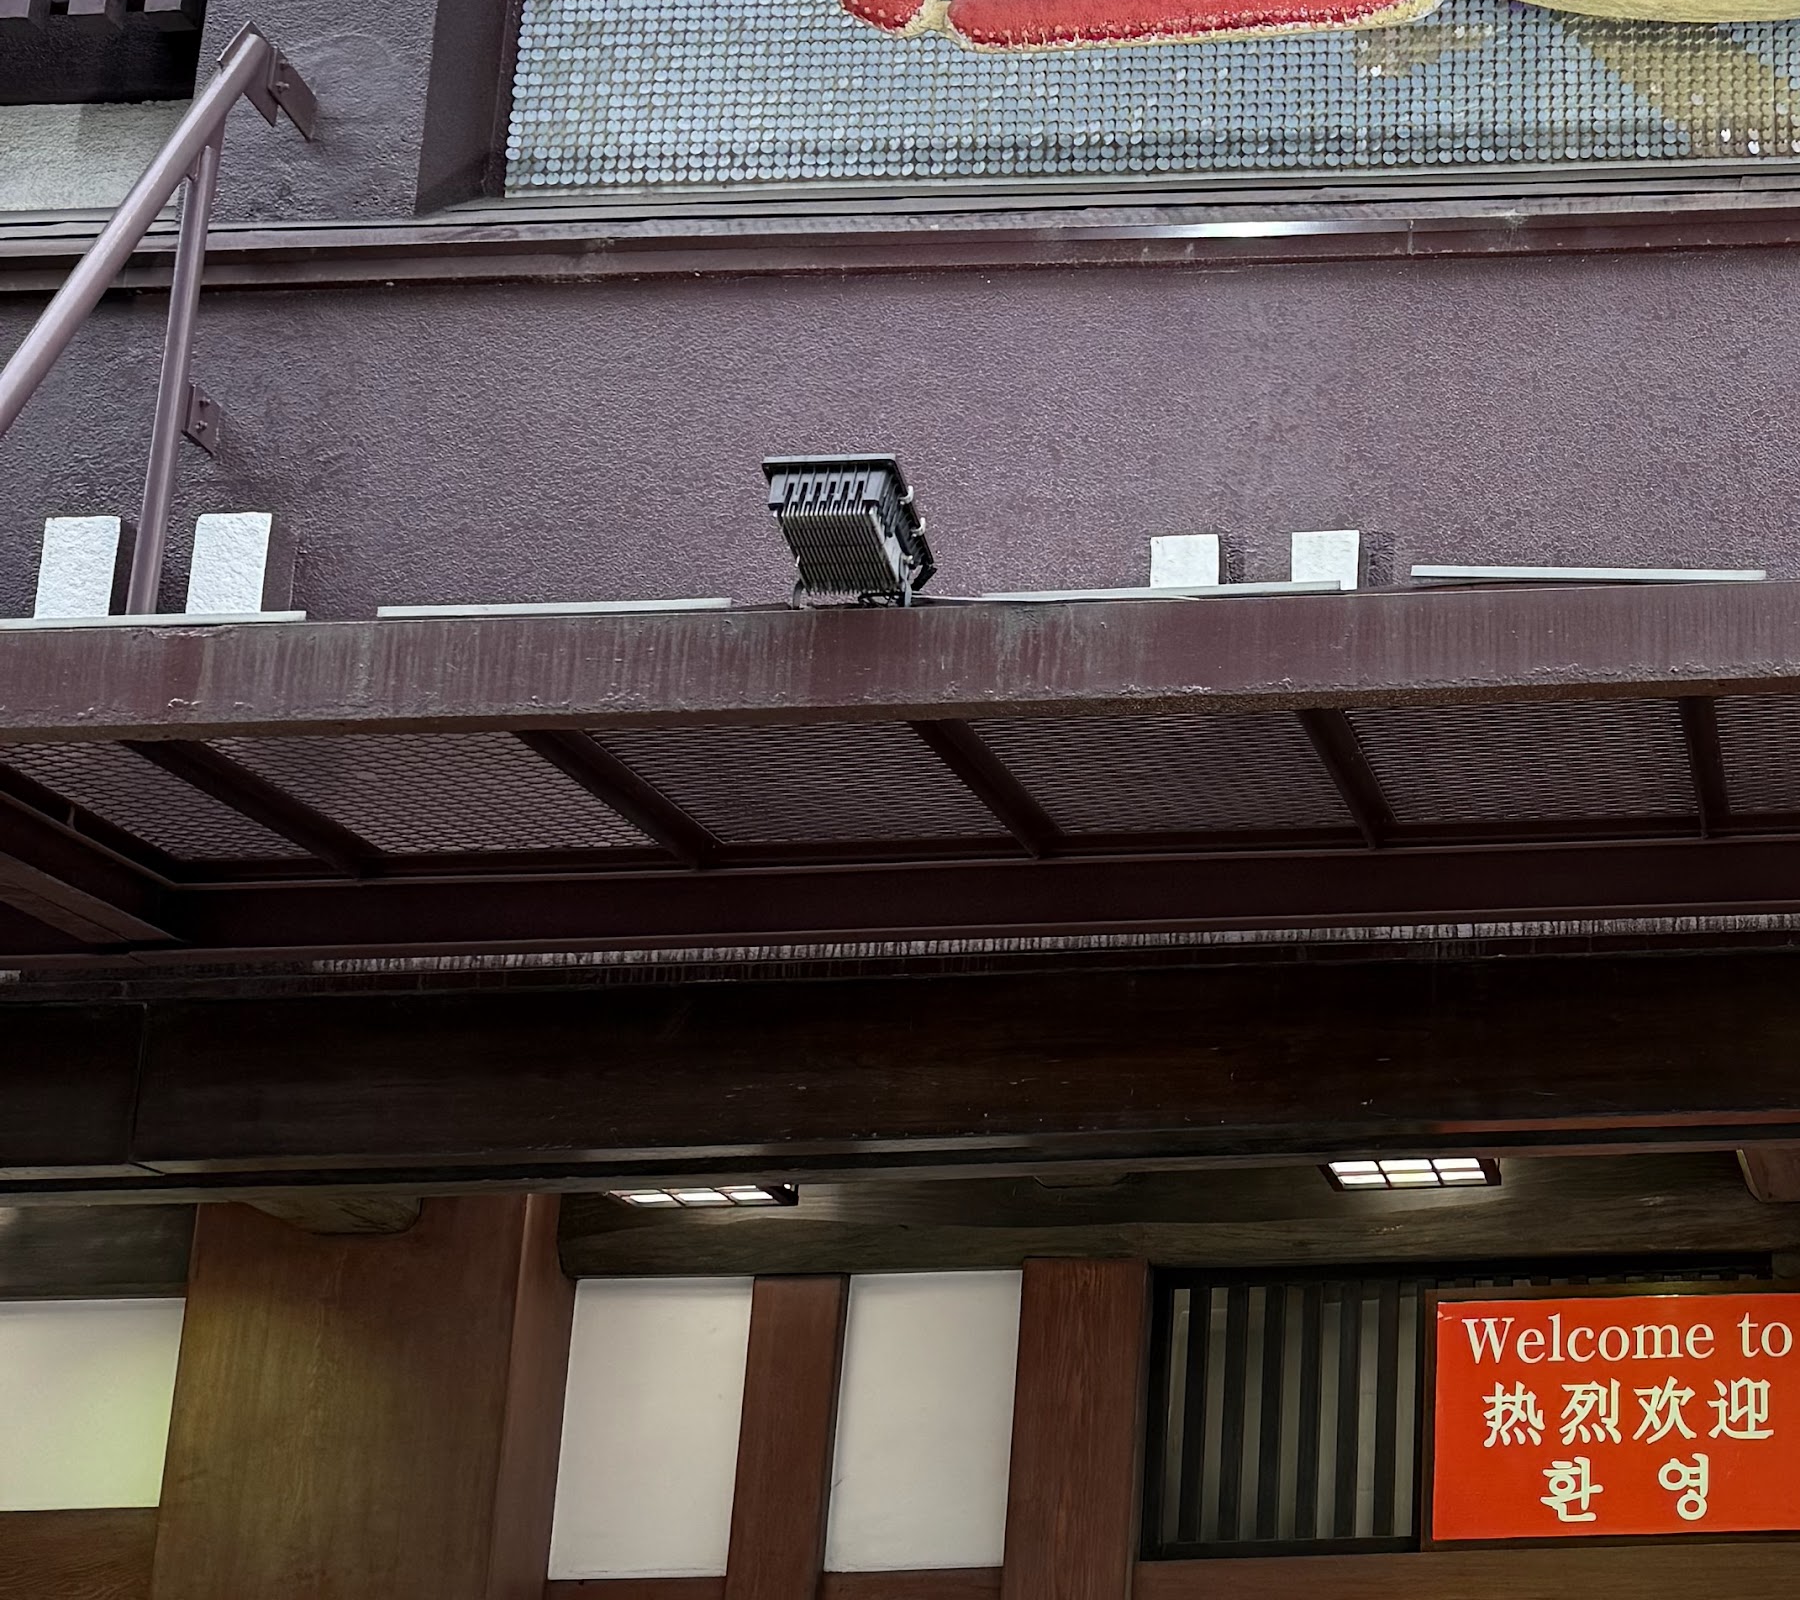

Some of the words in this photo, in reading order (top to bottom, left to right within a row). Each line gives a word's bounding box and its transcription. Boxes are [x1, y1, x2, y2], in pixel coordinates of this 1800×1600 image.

[1462, 1311, 1714, 1365] Welcome
[1736, 1317, 1794, 1359] to
[1482, 1376, 1776, 1449] 热烈欢迎
